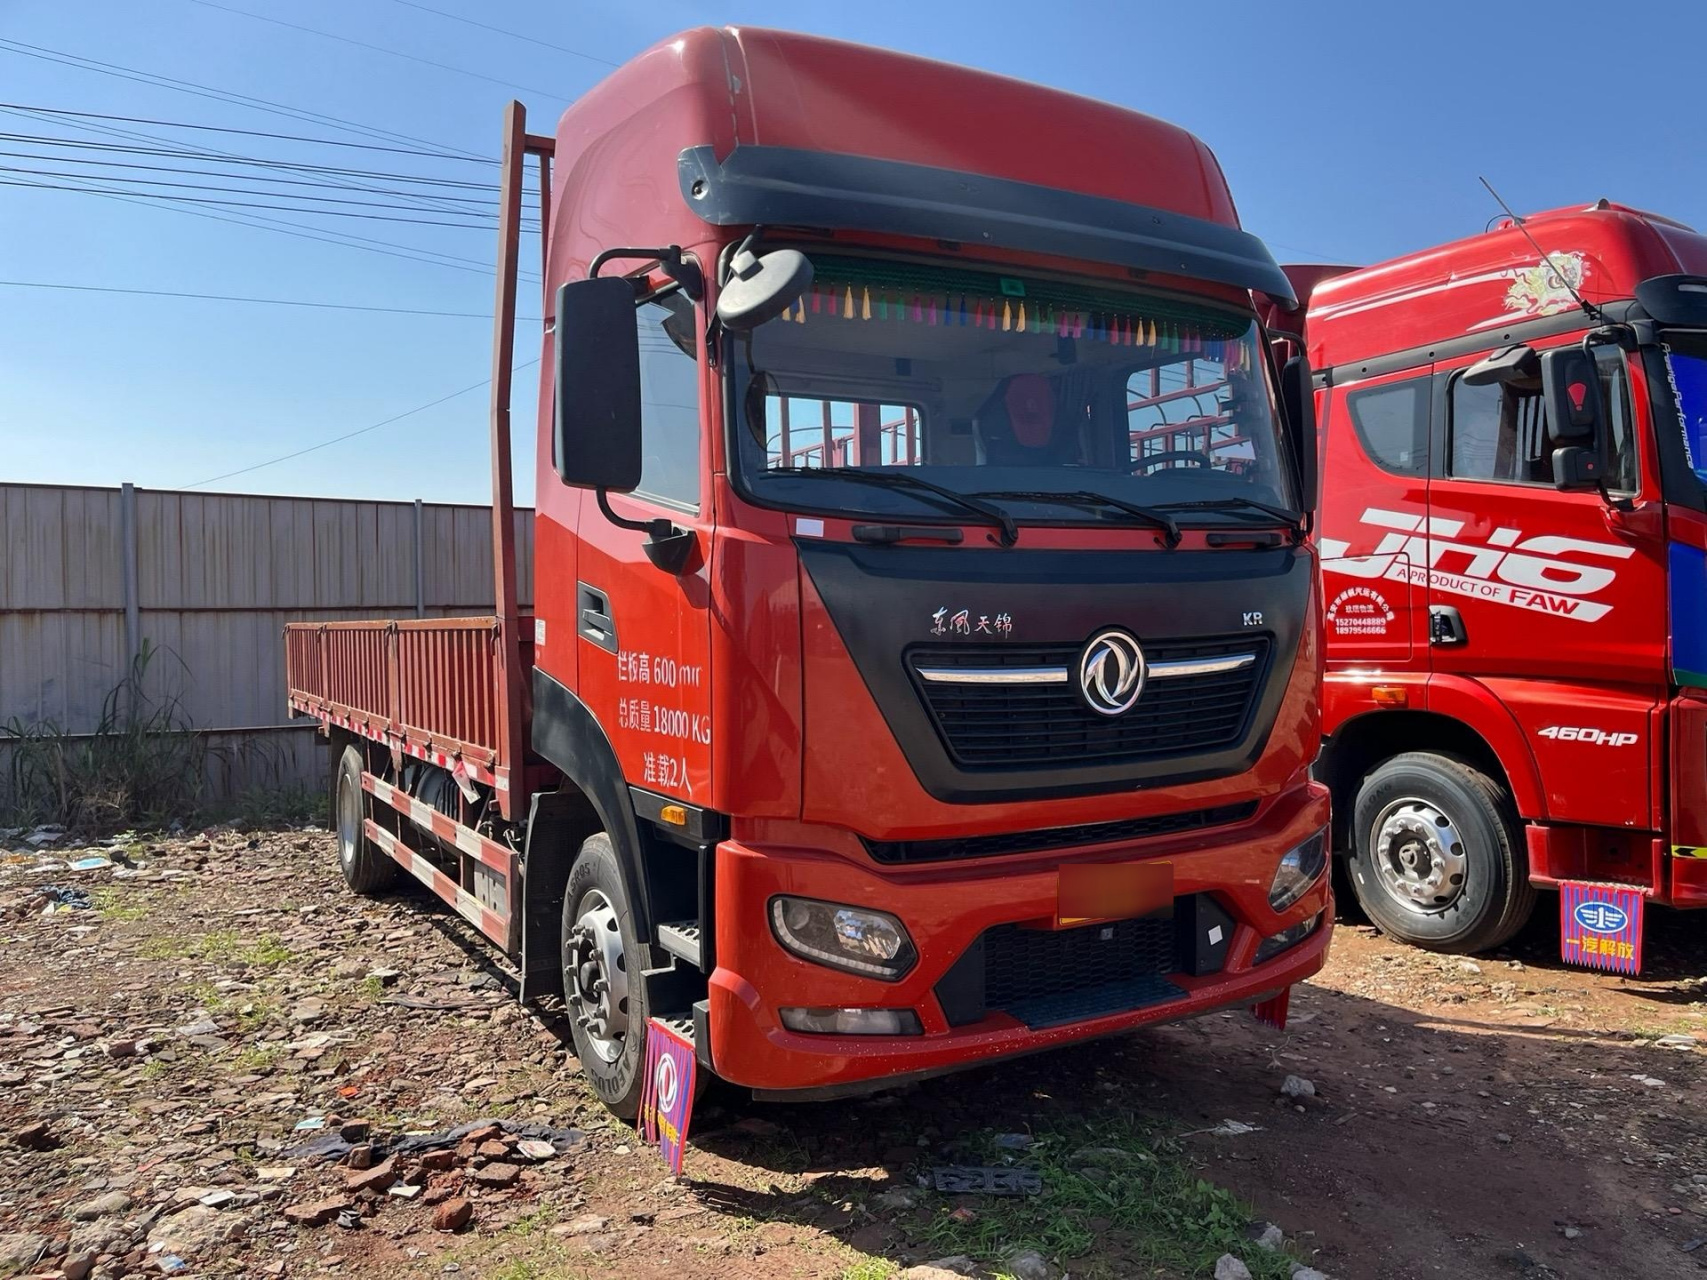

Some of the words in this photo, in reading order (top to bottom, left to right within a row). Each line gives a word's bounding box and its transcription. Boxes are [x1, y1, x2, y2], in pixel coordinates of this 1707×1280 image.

[1396, 567, 1409, 579] A
[1409, 570, 1478, 594] PRODUCT
[1480, 584, 1502, 598] OF
[1508, 588, 1581, 615] FAW
[929, 606, 1013, 640] 东风天锦
[1242, 611, 1263, 627] KR
[653, 656, 677, 688] 600
[618, 697, 651, 733] 总质量
[653, 705, 689, 740] 18000
[691, 713, 711, 745] KG
[1537, 725, 1639, 747] 460HP
[643, 751, 693, 796] 准载2人
[1565, 935, 1635, 960] 一汽解放
